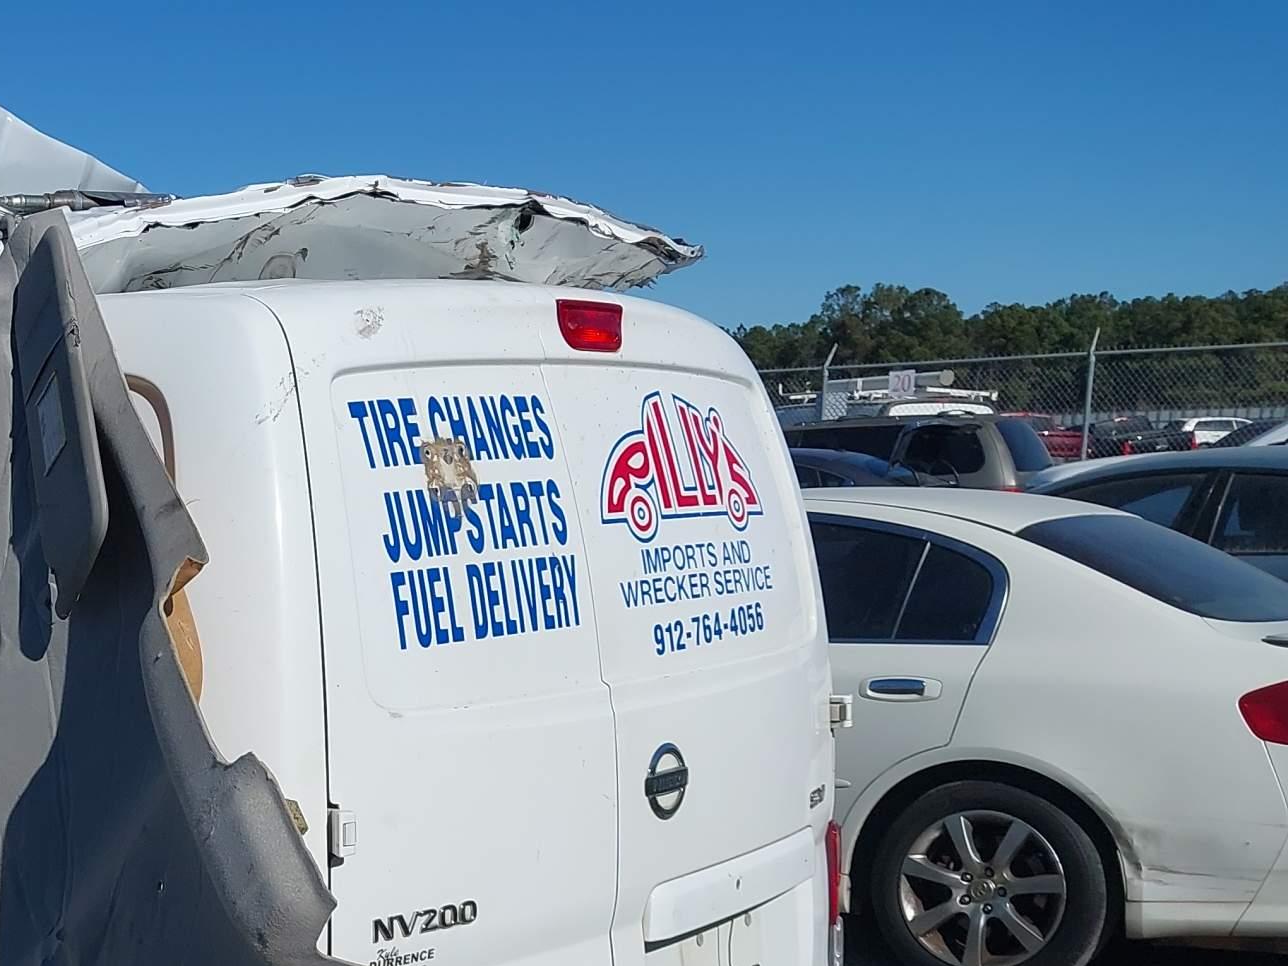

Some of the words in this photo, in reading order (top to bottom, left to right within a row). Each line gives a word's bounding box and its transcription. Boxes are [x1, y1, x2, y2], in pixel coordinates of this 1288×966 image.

[348, 398, 423, 468] TIRE
[428, 394, 554, 461] CHANGES
[383, 478, 568, 563] JUMPSTARTS
[640, 543, 718, 575] IMPORTS
[722, 540, 752, 565] AND
[391, 566, 464, 650] FUEL
[465, 554, 581, 640] DELIVERY
[620, 573, 710, 608] WRECKER
[714, 566, 773, 597] SERVICE
[654, 602, 765, 656] 912-764-4056
[372, 900, 478, 944] NV200
